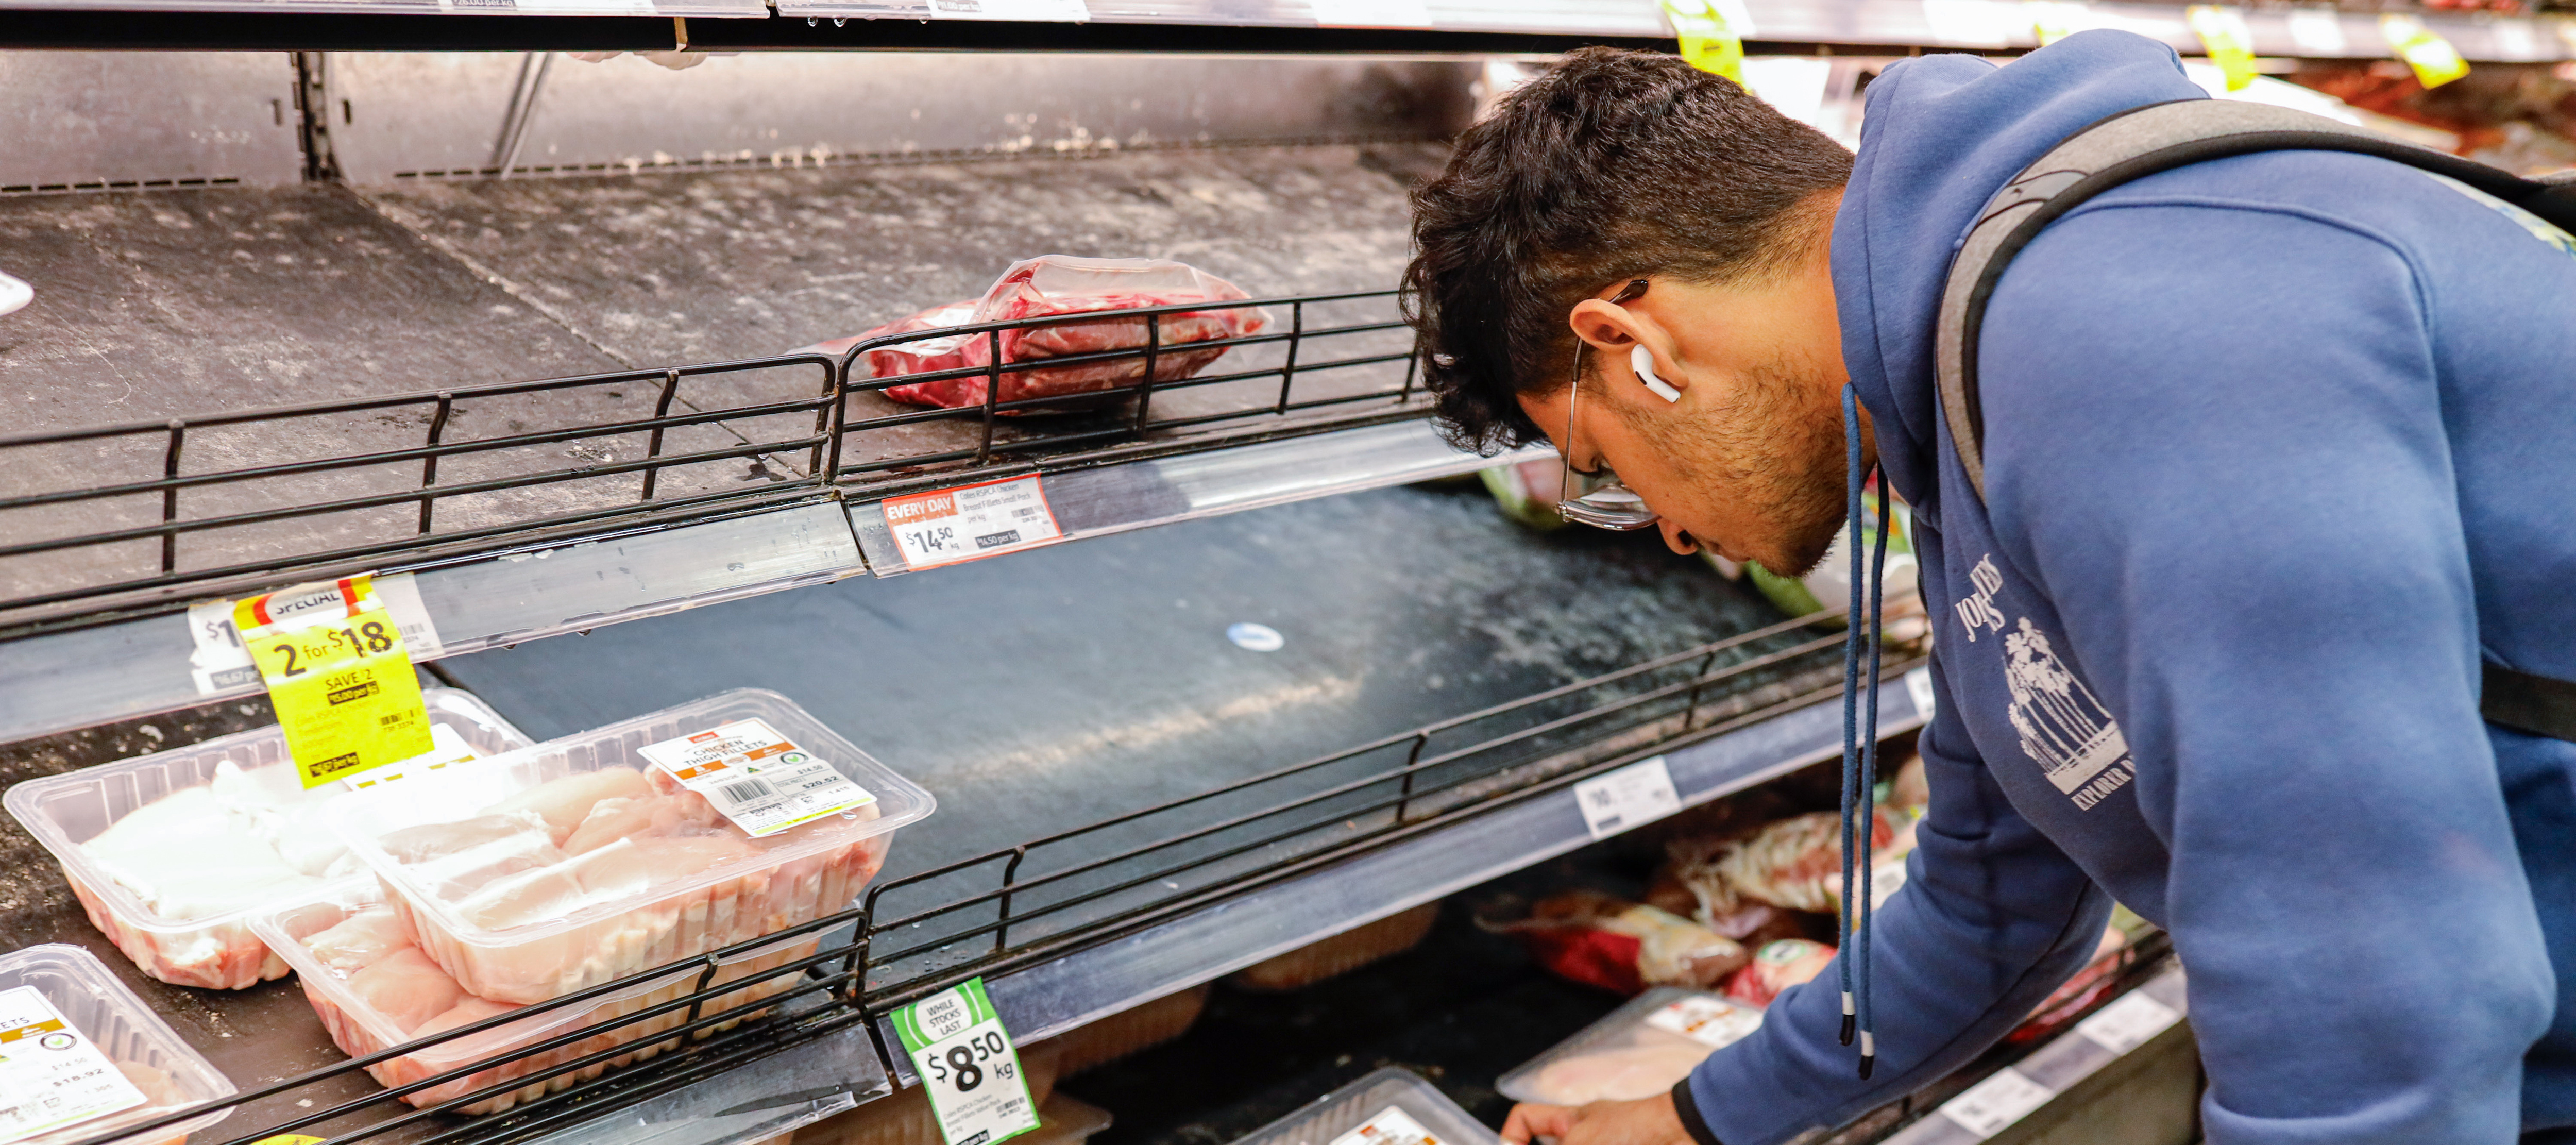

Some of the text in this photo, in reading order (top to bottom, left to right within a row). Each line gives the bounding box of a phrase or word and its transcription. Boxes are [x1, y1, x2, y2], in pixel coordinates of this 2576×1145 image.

[959, 483, 1020, 500] Coles RSPCA Chicken
[887, 496, 951, 520] EVERY DAY
[962, 503, 982, 512] Breast
[1016, 492, 1031, 501] Pack
[967, 513, 986, 524] per kg
[949, 542, 960, 550] kg
[997, 535, 1008, 545] per
[1008, 532, 1019, 541] kg
[273, 644, 307, 677] 2
[303, 645, 329, 660] for
[327, 621, 393, 658] $18
[325, 672, 360, 691] SAVE
[683, 752, 723, 766] THIGH
[722, 740, 768, 756] FILLETS
[693, 739, 744, 756] CHICKEN
[796, 764, 824, 774] $14.50
[802, 775, 840, 789] $20.52
[2071, 768, 2132, 812] EXPLORER
[926, 998, 955, 1016] WHILE
[0, 1017, 30, 1029] ETS
[929, 1007, 961, 1028] STOCKS
[939, 1019, 962, 1035] LAST
[53, 1068, 105, 1087] $18.92
[994, 1062, 1013, 1080] kg
